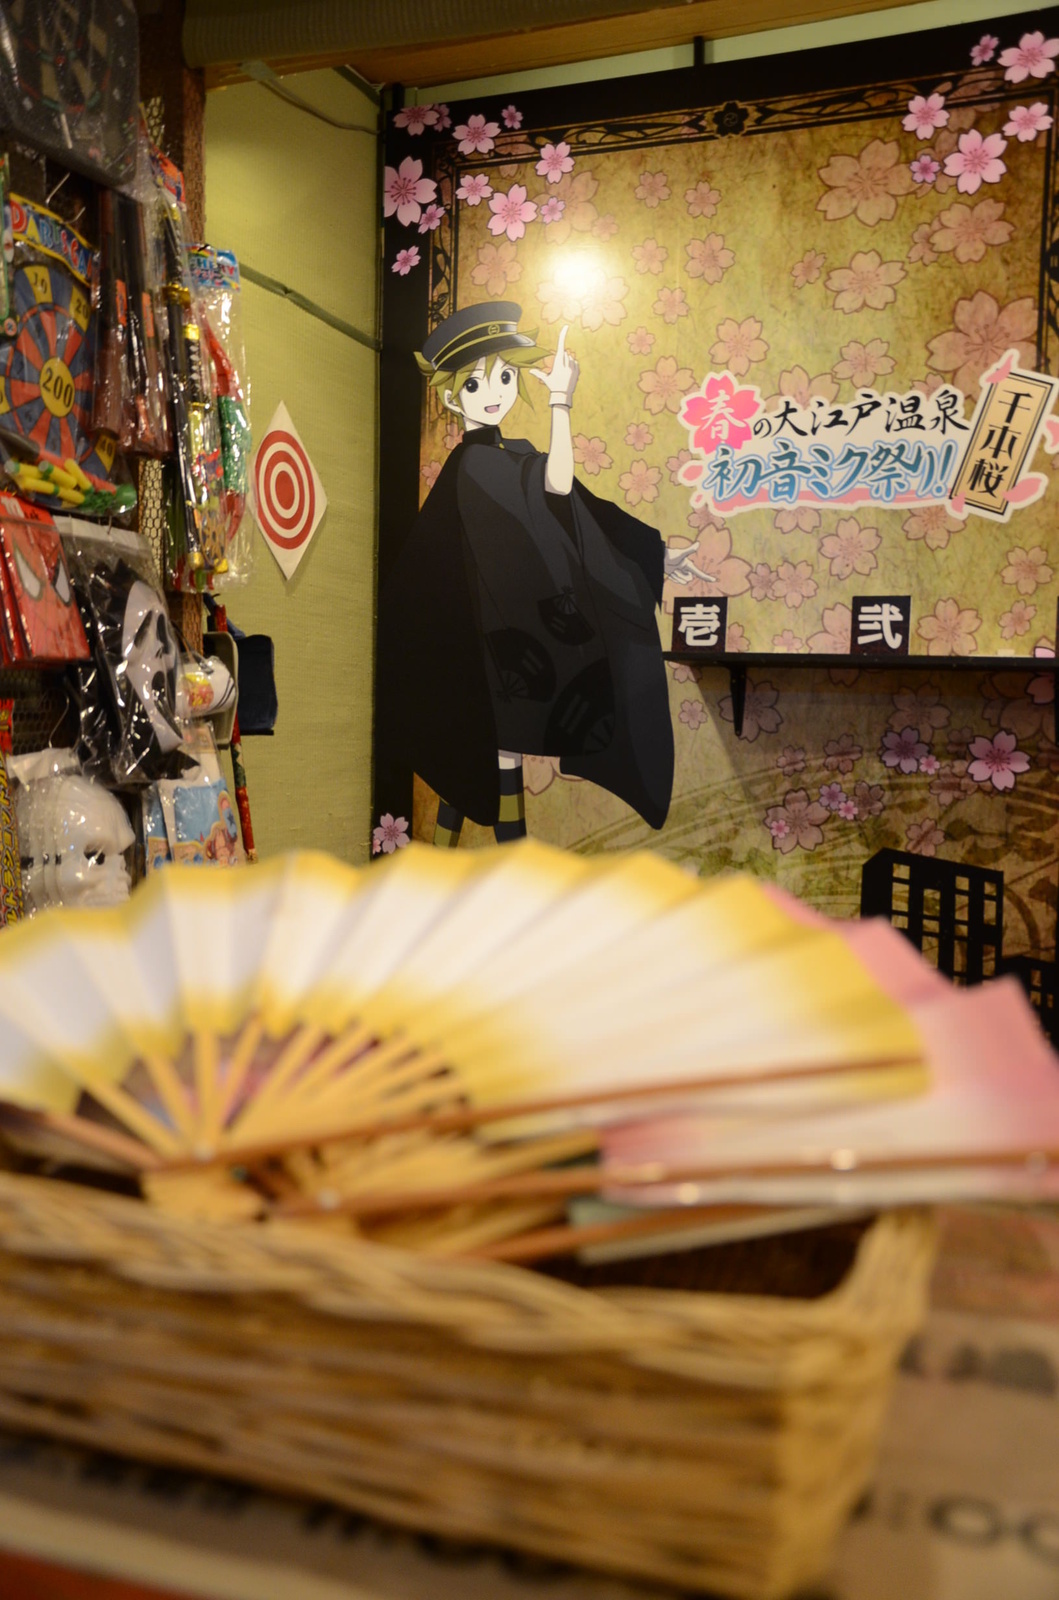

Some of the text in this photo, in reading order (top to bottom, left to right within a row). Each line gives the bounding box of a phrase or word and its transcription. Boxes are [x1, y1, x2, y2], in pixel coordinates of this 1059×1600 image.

[10, 200, 68, 255] DARTS
[33, 271, 47, 294] 10
[75, 299, 89, 315] 20
[42, 367, 74, 408] 200
[700, 388, 971, 445] 春の大江戸温泉
[967, 389, 1034, 499] 千本桜
[678, 603, 722, 646] 壱
[857, 603, 904, 649] 弐
